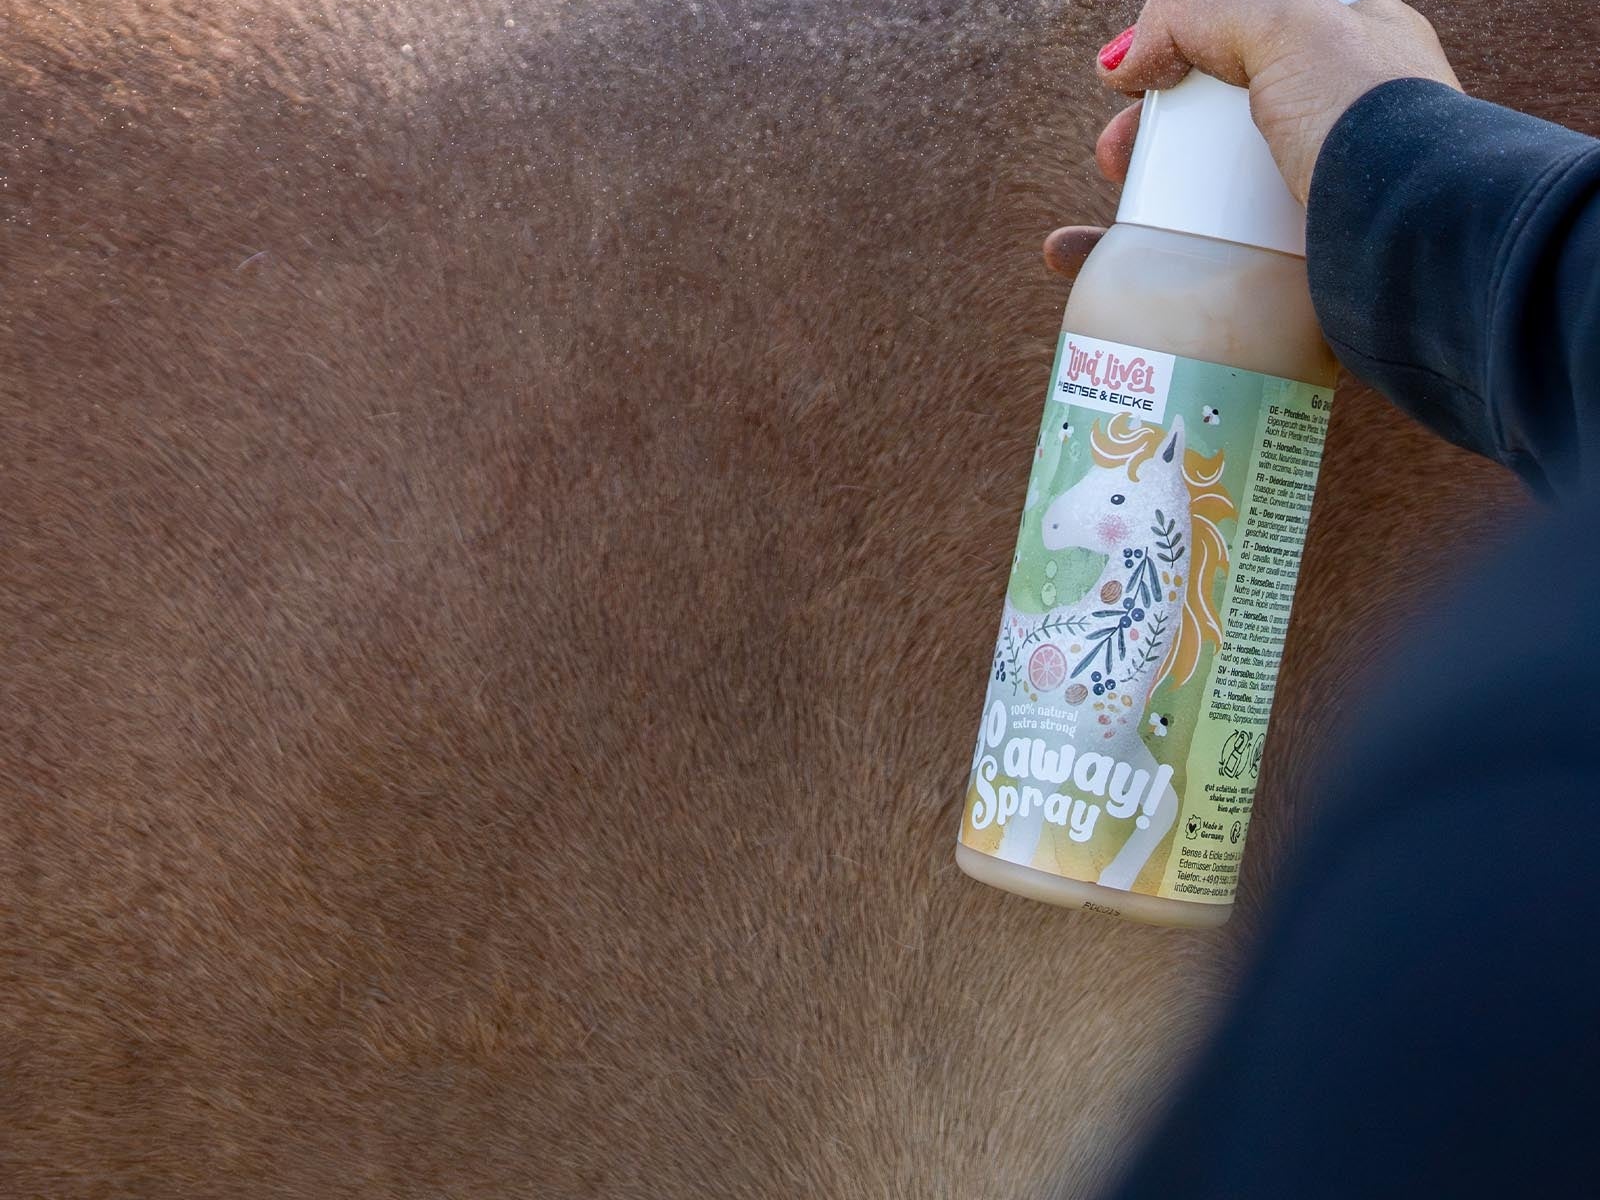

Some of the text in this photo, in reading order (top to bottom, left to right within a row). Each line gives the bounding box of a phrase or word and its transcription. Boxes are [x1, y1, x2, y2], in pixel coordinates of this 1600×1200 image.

[1062, 382, 1098, 399] BENSE
[1100, 391, 1108, 400] &
[1109, 393, 1154, 411] EICKE
[1270, 406, 1279, 415] DE
[1263, 440, 1272, 448] EN
[1256, 472, 1265, 482] FR
[1250, 506, 1258, 516] NL
[1243, 540, 1250, 549] IT
[1236, 574, 1245, 583] ES
[1230, 608, 1239, 616] PT
[1223, 642, 1232, 651] DA
[1218, 665, 1227, 674] SV
[1213, 689, 1221, 698] PL
[1011, 704, 1079, 722] 100% natural
[1013, 717, 1077, 738] extra strong
[1003, 737, 1175, 830] away!
[1205, 784, 1215, 792] gut
[972, 755, 1101, 842] Spray
[1210, 794, 1225, 802] shake
[1203, 822, 1217, 830] Made
[1200, 831, 1224, 842] Germany
[1181, 846, 1202, 858] Bense
[1203, 850, 1208, 859] &
[1209, 851, 1222, 860] Eicke
